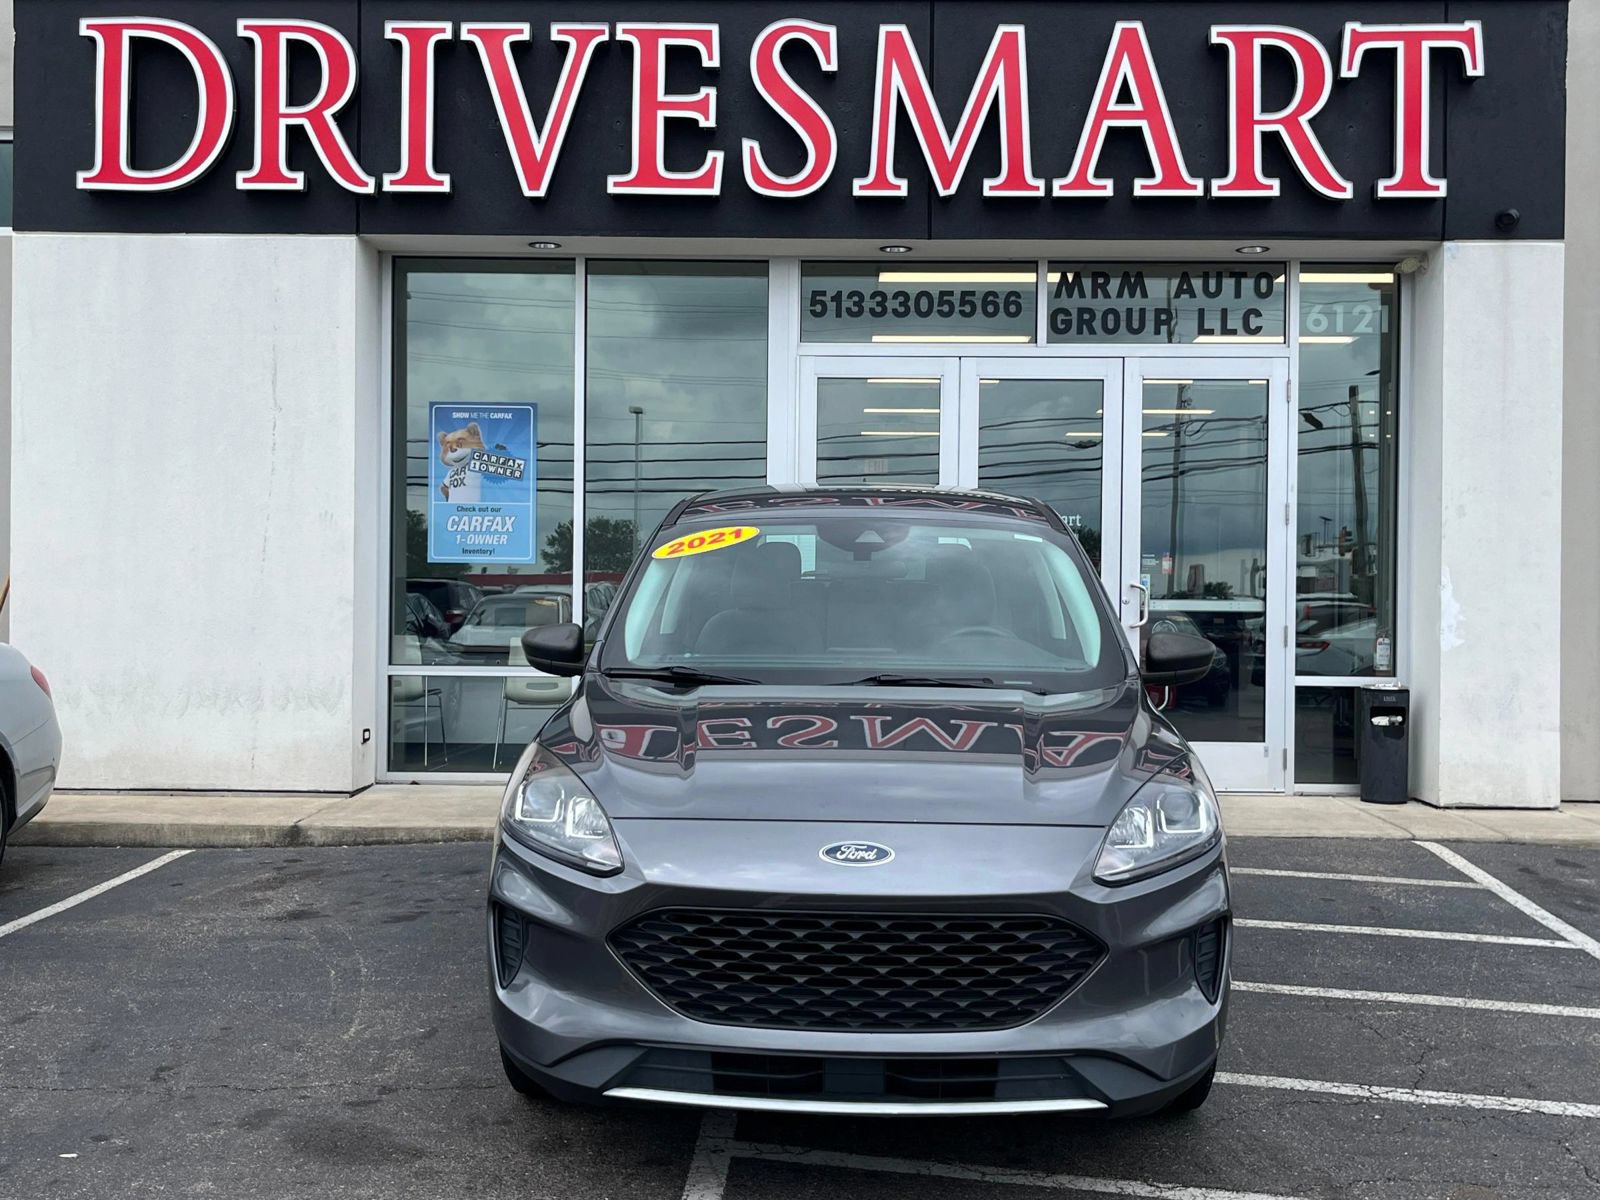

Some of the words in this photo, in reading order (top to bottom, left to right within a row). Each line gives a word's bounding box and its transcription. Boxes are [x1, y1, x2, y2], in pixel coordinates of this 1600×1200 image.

[76, 16, 1485, 200] DRIVESMART
[1054, 270, 1149, 299] MRM
[1173, 270, 1275, 299] AUTO
[809, 289, 1023, 319] 5133305566
[1049, 307, 1174, 336] GROUP
[1197, 307, 1264, 336] LLC
[1306, 304, 1389, 333] 6121
[473, 451, 523, 470] CARFAX
[450, 466, 467, 479] CAR
[450, 477, 467, 488] FOX
[447, 515, 515, 532] CARFAX
[456, 534, 508, 545] 1-OWNER
[666, 527, 743, 556] 2021
[462, 547, 496, 556] Inventory!
[836, 844, 878, 860] Ford
